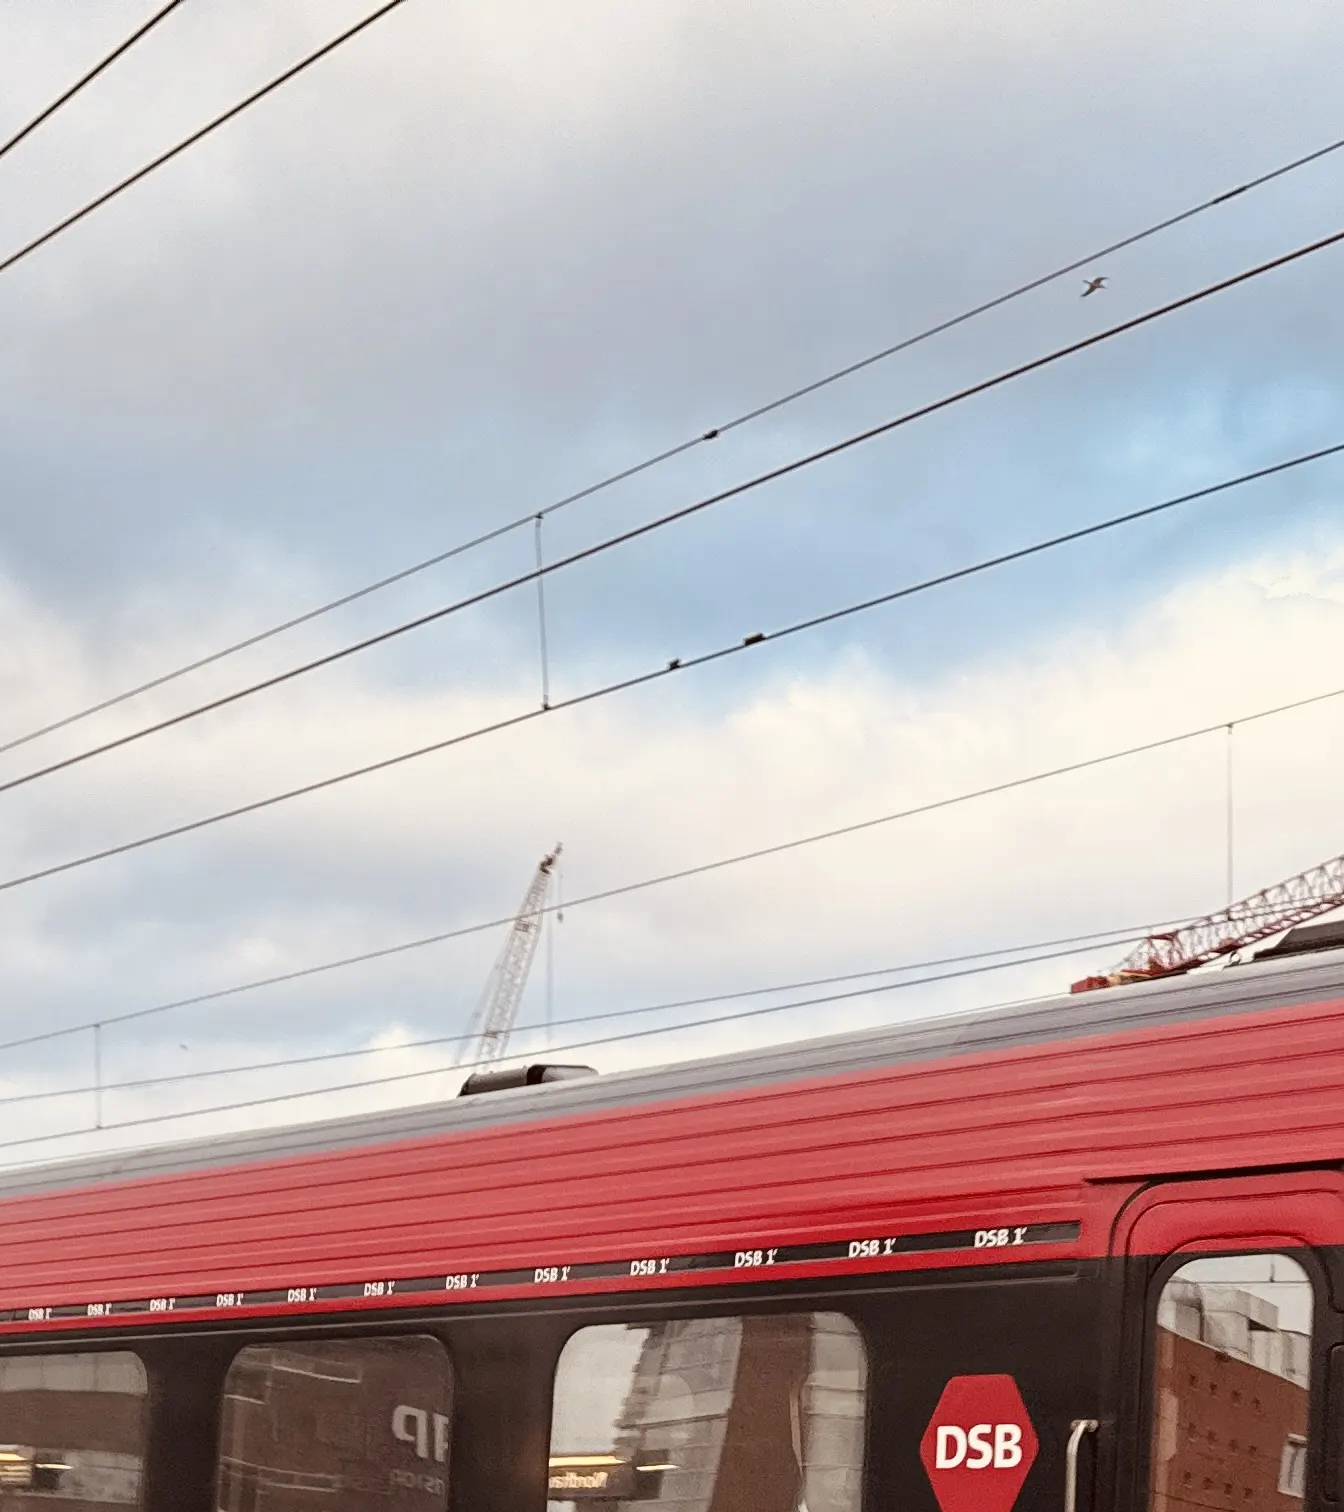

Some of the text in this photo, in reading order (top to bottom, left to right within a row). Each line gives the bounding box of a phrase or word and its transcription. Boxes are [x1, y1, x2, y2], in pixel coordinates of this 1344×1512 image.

[974, 1229, 1009, 1247] DSB
[848, 1240, 880, 1258] DSB
[734, 1250, 763, 1267] DSB
[534, 1268, 559, 1282] DSB
[629, 1260, 655, 1275] DSB
[363, 1282, 385, 1296] DSB
[446, 1275, 468, 1290] DSB
[216, 1294, 235, 1307] DSB
[287, 1289, 306, 1303] DSB
[935, 1424, 1022, 1469] DSB
